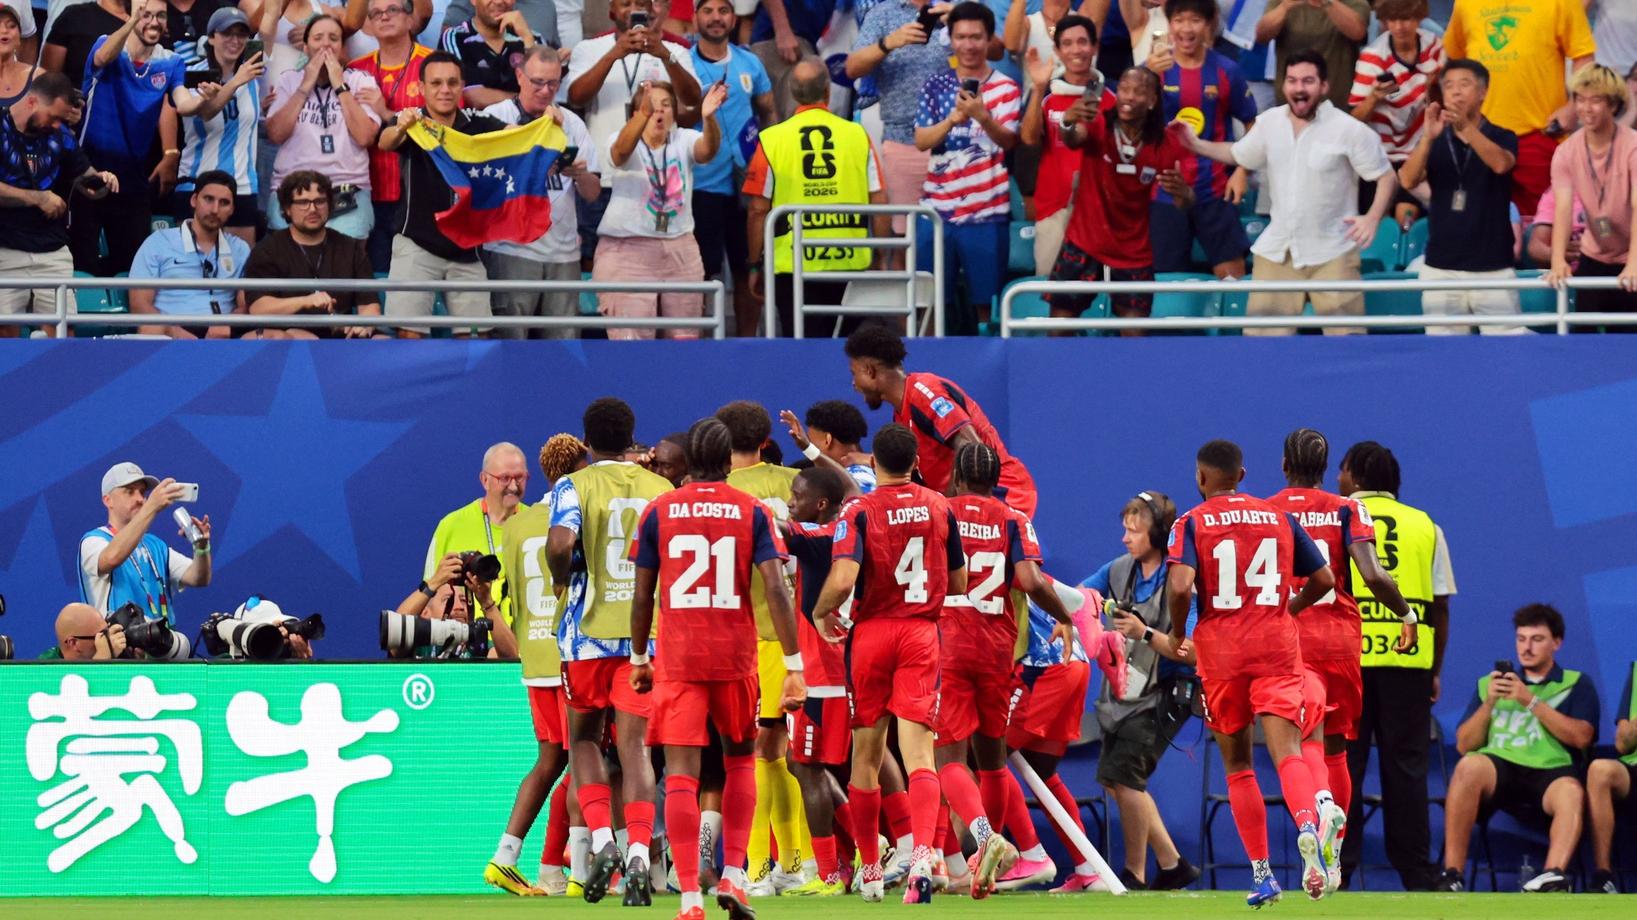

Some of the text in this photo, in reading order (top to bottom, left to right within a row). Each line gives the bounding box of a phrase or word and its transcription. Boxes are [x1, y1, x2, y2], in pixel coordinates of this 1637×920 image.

[811, 167, 829, 176] FIFA
[803, 188, 838, 197] 2026
[787, 212, 861, 226] CURITY
[668, 502, 741, 520] DA COSTA
[886, 506, 930, 525] LOPES
[957, 522, 1001, 540] REIRA
[618, 563, 635, 573] FIF
[668, 534, 741, 609] 21
[894, 536, 928, 603] 4
[1213, 537, 1281, 609] 14
[606, 582, 635, 590] WORL
[605, 590, 635, 602] 20
[529, 619, 553, 629] WORL
[26, 674, 400, 883] 蒙牛
